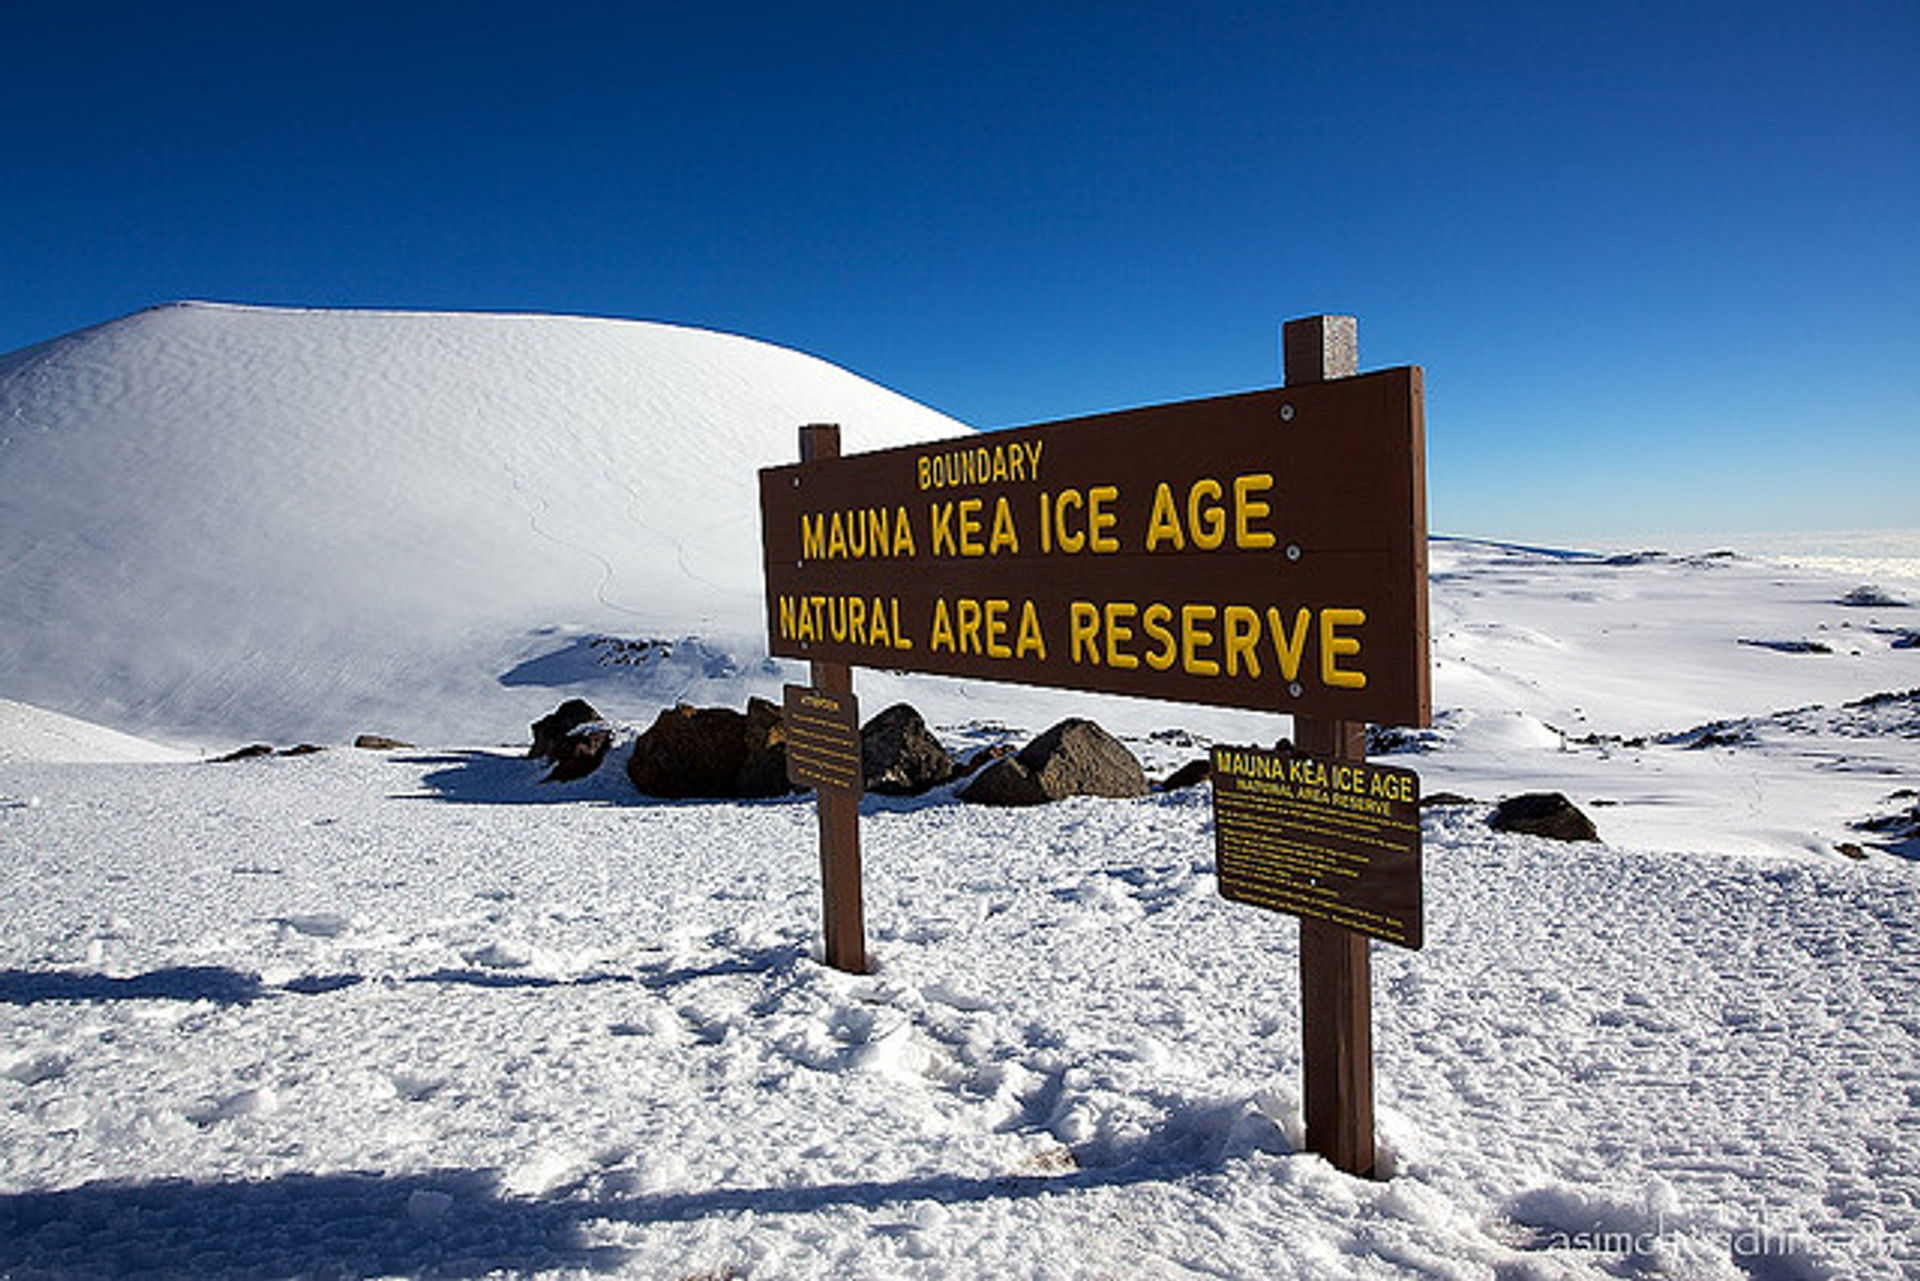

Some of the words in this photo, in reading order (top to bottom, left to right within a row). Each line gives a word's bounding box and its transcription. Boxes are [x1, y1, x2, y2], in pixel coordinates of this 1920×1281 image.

[917, 440, 1042, 491] BOUNDARY
[801, 505, 916, 561] MAUNA
[931, 497, 1020, 557] KEA
[1039, 485, 1121, 554] ICE
[1145, 474, 1277, 552] AGE
[778, 594, 914, 650] NATURAL
[931, 598, 1046, 660] AREA
[1070, 601, 1367, 689] RESERVE
[1216, 751, 1285, 780] MAUNA
[1289, 758, 1330, 788] KEA
[1331, 766, 1366, 795] ICE
[1371, 772, 1414, 804] AGE
[1332, 794, 1391, 816] RESERVE
